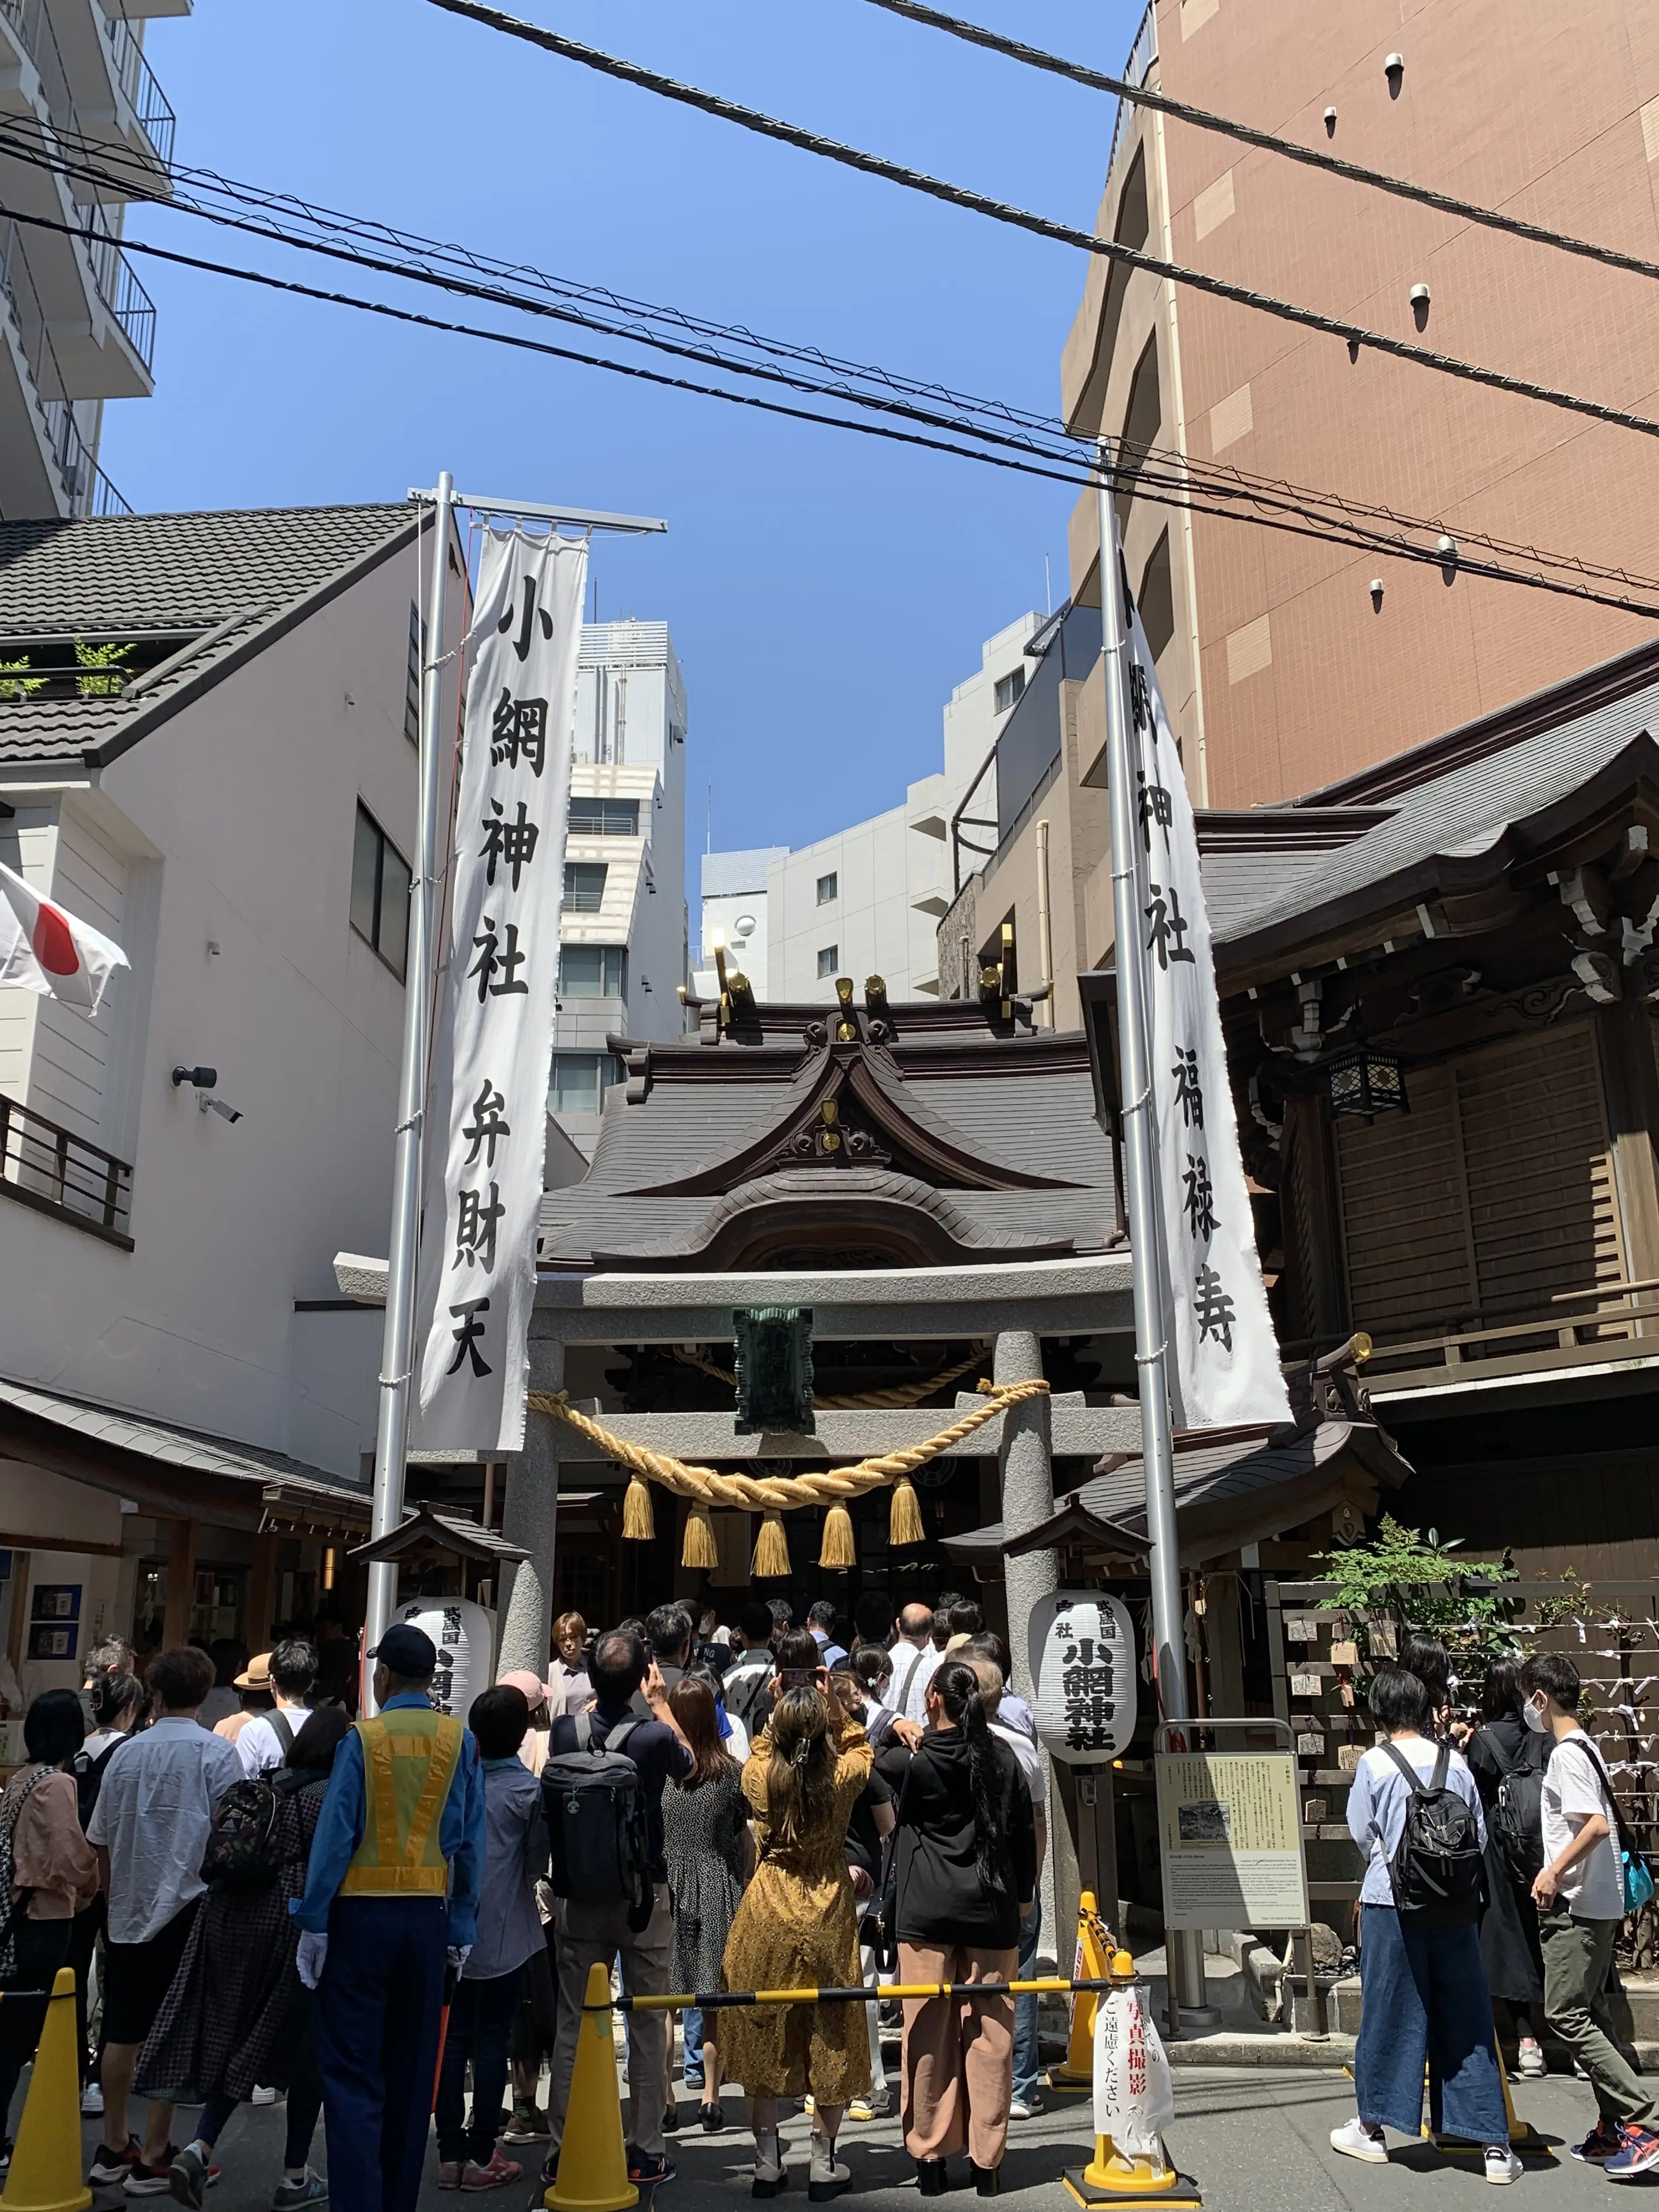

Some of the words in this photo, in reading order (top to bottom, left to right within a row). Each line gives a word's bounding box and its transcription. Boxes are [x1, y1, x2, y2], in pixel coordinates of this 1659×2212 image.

[467, 575, 553, 1005] 小網神社
[446, 1079, 511, 1378] 弁財天
[1170, 1044, 1236, 1354] 福禄寿
[1095, 1600, 1116, 1640] 武蔵国
[1062, 1638, 1116, 1752] 小網神社
[1104, 2000, 1120, 2117] ご遠慮ください
[1126, 2000, 1147, 2096] 写真撮影
